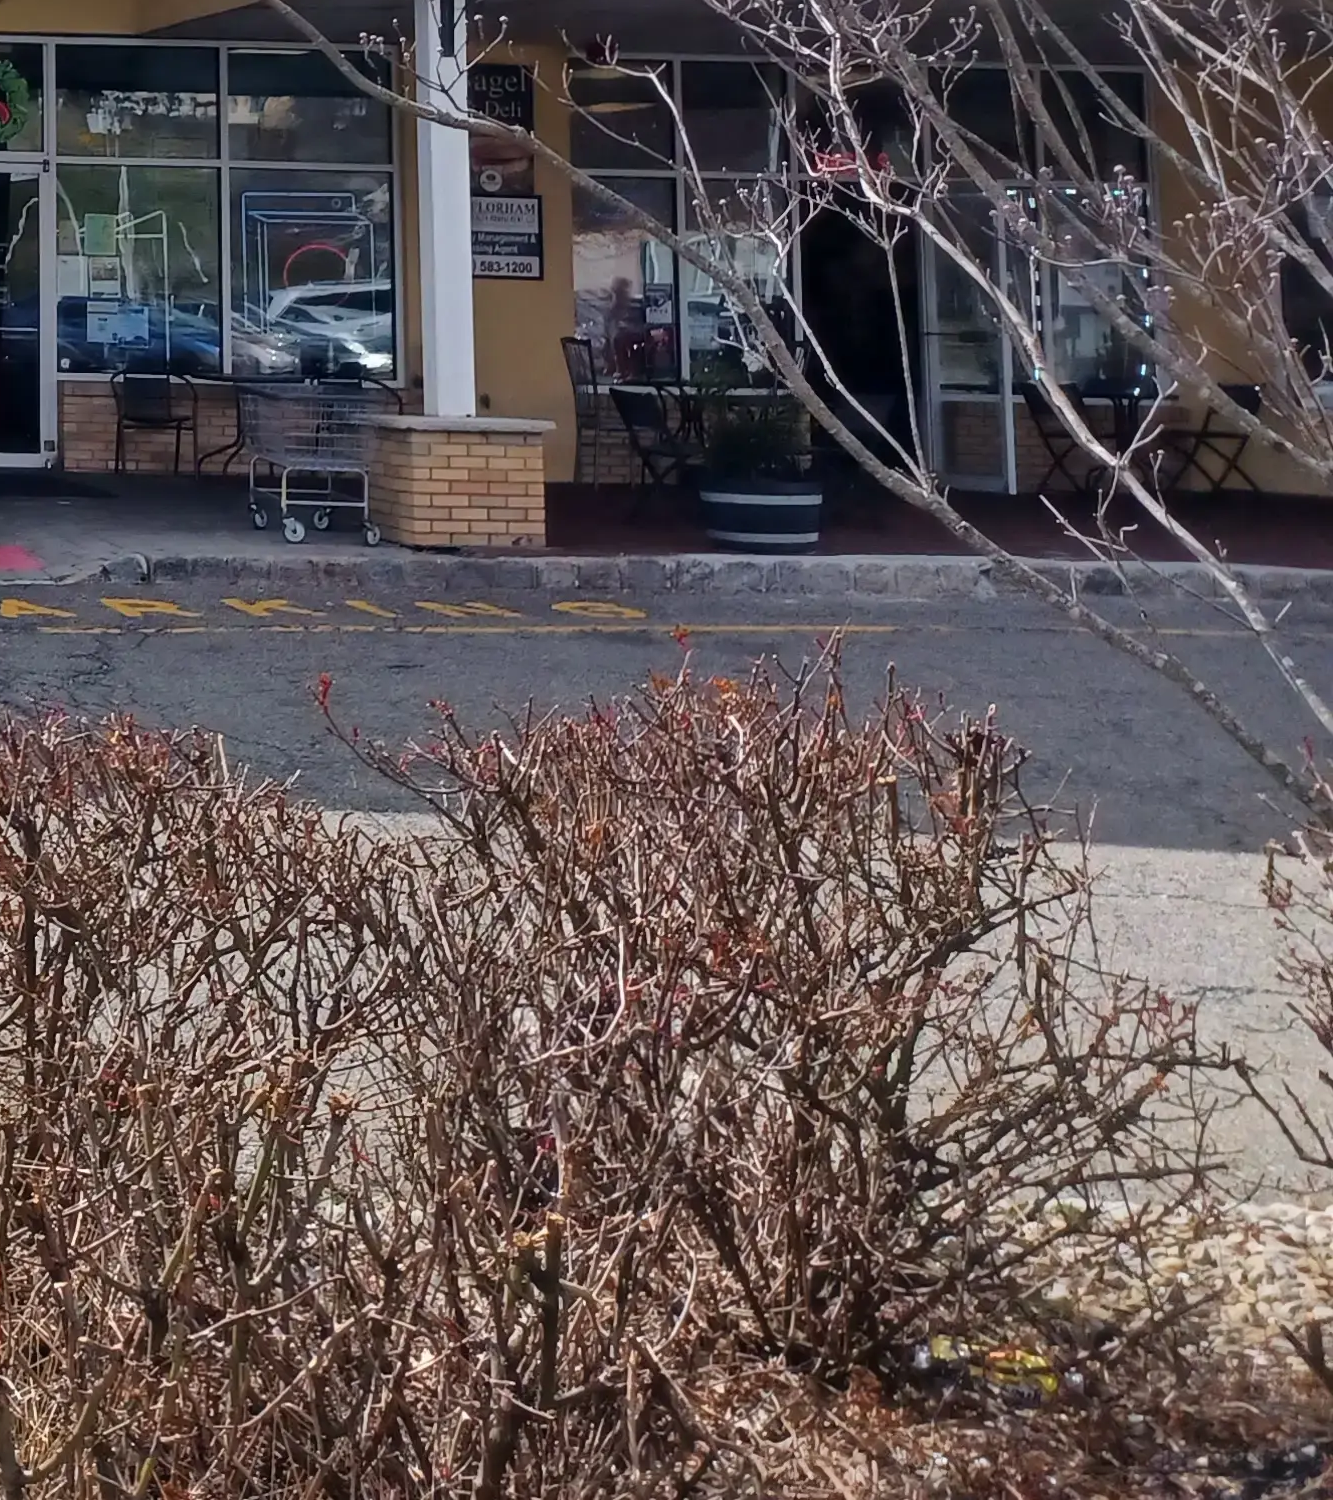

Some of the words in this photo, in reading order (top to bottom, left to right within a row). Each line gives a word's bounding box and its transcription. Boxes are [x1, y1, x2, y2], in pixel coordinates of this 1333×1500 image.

[469, 67, 526, 98] agel
[485, 100, 521, 117] Deli
[479, 261, 533, 273] 583-1200
